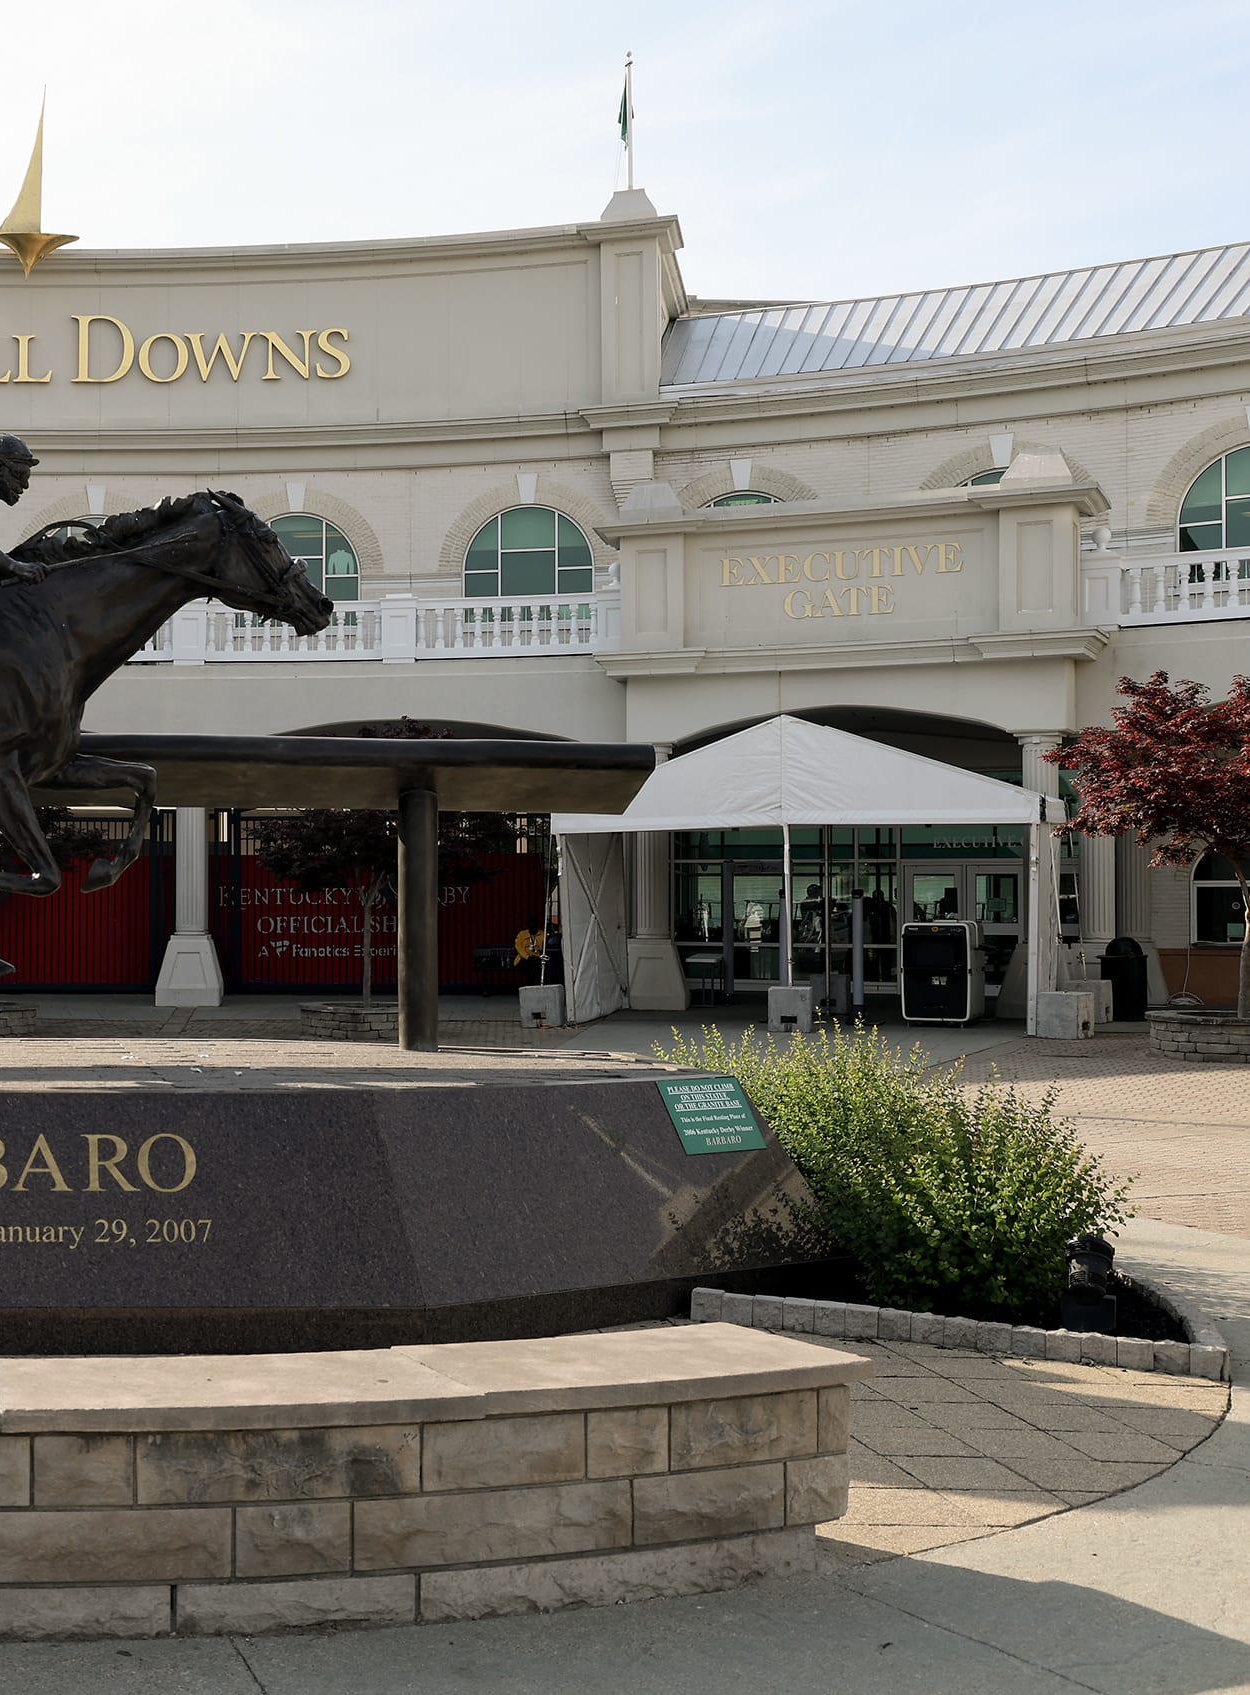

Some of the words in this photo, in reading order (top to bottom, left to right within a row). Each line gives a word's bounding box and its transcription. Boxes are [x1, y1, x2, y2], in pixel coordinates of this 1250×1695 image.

[71, 313, 352, 384] DOWNS
[720, 542, 964, 587] EXECUTIVE
[782, 584, 896, 620] GATE
[933, 835, 1017, 849] EXECUTIVE
[257, 915, 363, 934] OFFICIAL
[370, 915, 397, 934] SH
[257, 946, 270, 958] A
[292, 944, 350, 958] Fanatics
[353, 945, 397, 959] Eperi
[666, 1086, 690, 1094] PLEASE
[701, 1084, 714, 1092] NOT
[714, 1083, 735, 1091] CLIMB
[680, 1094, 691, 1102] ON
[691, 1093, 705, 1101] THIS
[705, 1092, 728, 1100] STATUE
[674, 1103, 684, 1111] OR
[684, 1102, 697, 1110] THE
[698, 1101, 725, 1109] GRANITE
[720, 1126, 735, 1134] Derby
[705, 1135, 742, 1146] BARBARO
[94, 1218, 138, 1247] 29,
[145, 1218, 214, 1244] 2007
